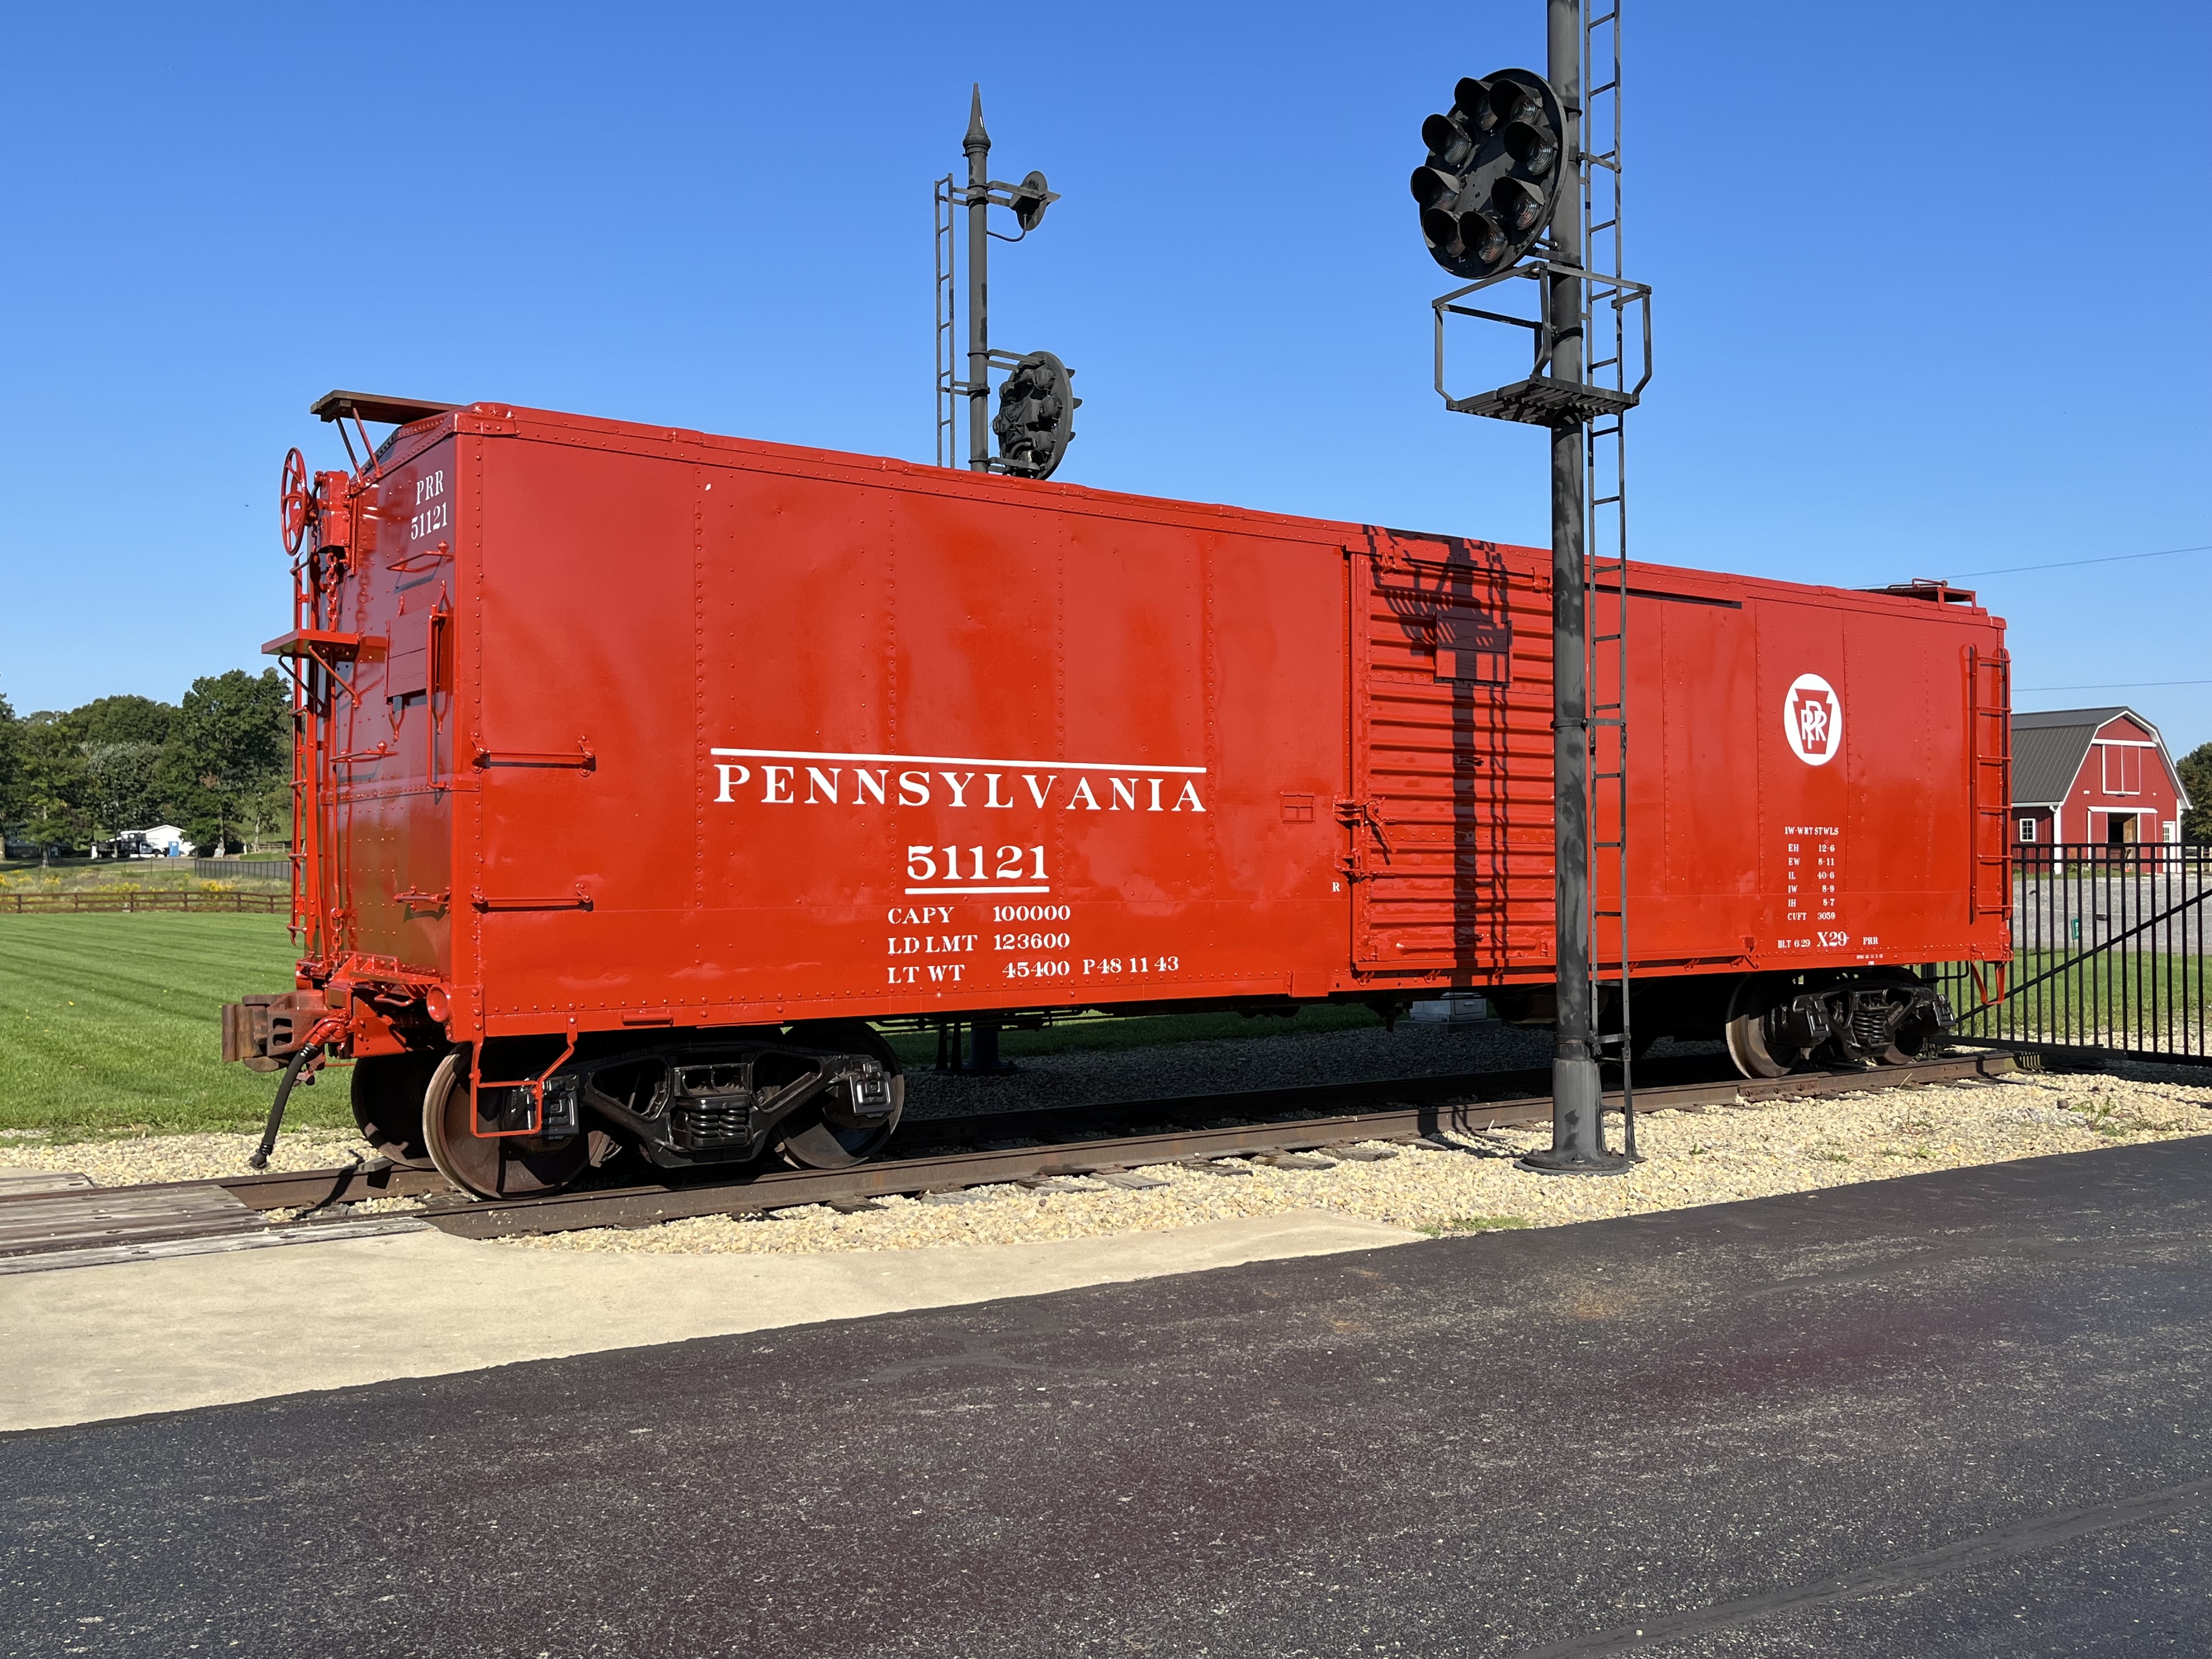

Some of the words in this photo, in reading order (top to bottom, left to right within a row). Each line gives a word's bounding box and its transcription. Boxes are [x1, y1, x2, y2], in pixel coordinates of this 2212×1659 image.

[416, 470, 444, 505] PRR
[411, 501, 448, 540] 51121
[713, 764, 1207, 812] PENNSYLVANIA
[1788, 843, 1799, 852] EH
[907, 845, 1049, 881] 51121
[1788, 857, 1801, 866] EW
[1788, 871, 1796, 880] IL
[1332, 882, 1340, 892] R
[1788, 885, 1798, 894] IW
[1788, 899, 1796, 907] IH
[888, 906, 955, 924] CAPY
[992, 905, 1071, 922] 100000
[887, 937, 919, 955] LD
[925, 934, 978, 953] LMT
[994, 933, 1070, 950] 123600
[1778, 939, 1792, 949] BLT
[1816, 931, 1847, 947] X29
[1863, 936, 1878, 945] PRR
[887, 966, 919, 984] LT
[927, 964, 965, 982] WT
[1002, 961, 1070, 978] 45400
[1082, 958, 1122, 975] P48
[1130, 957, 1149, 973] 11
[1154, 956, 1179, 972] 43
